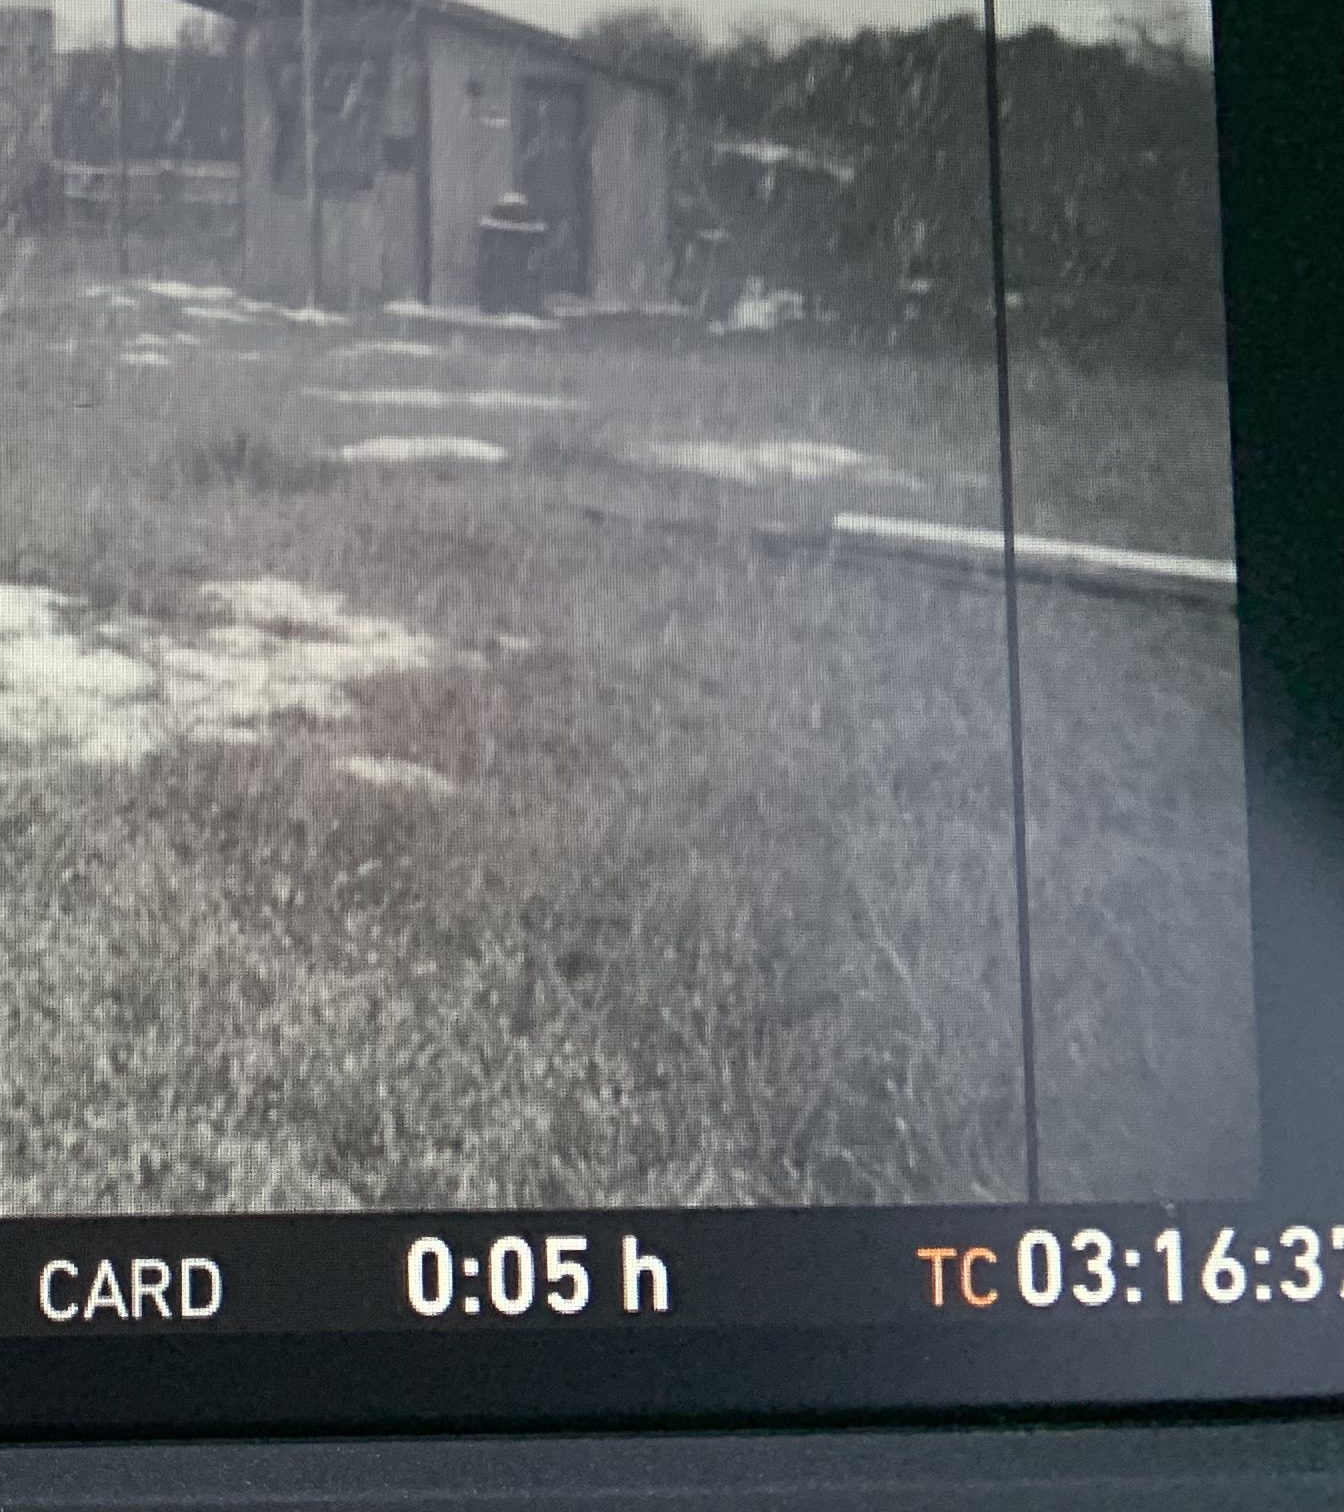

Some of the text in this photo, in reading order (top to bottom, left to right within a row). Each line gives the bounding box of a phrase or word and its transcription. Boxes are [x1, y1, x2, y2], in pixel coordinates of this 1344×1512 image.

[39, 1257, 222, 1321] CARD
[407, 1235, 669, 1316] 0:05 h
[917, 1225, 1344, 1307] TC 03:16:3
